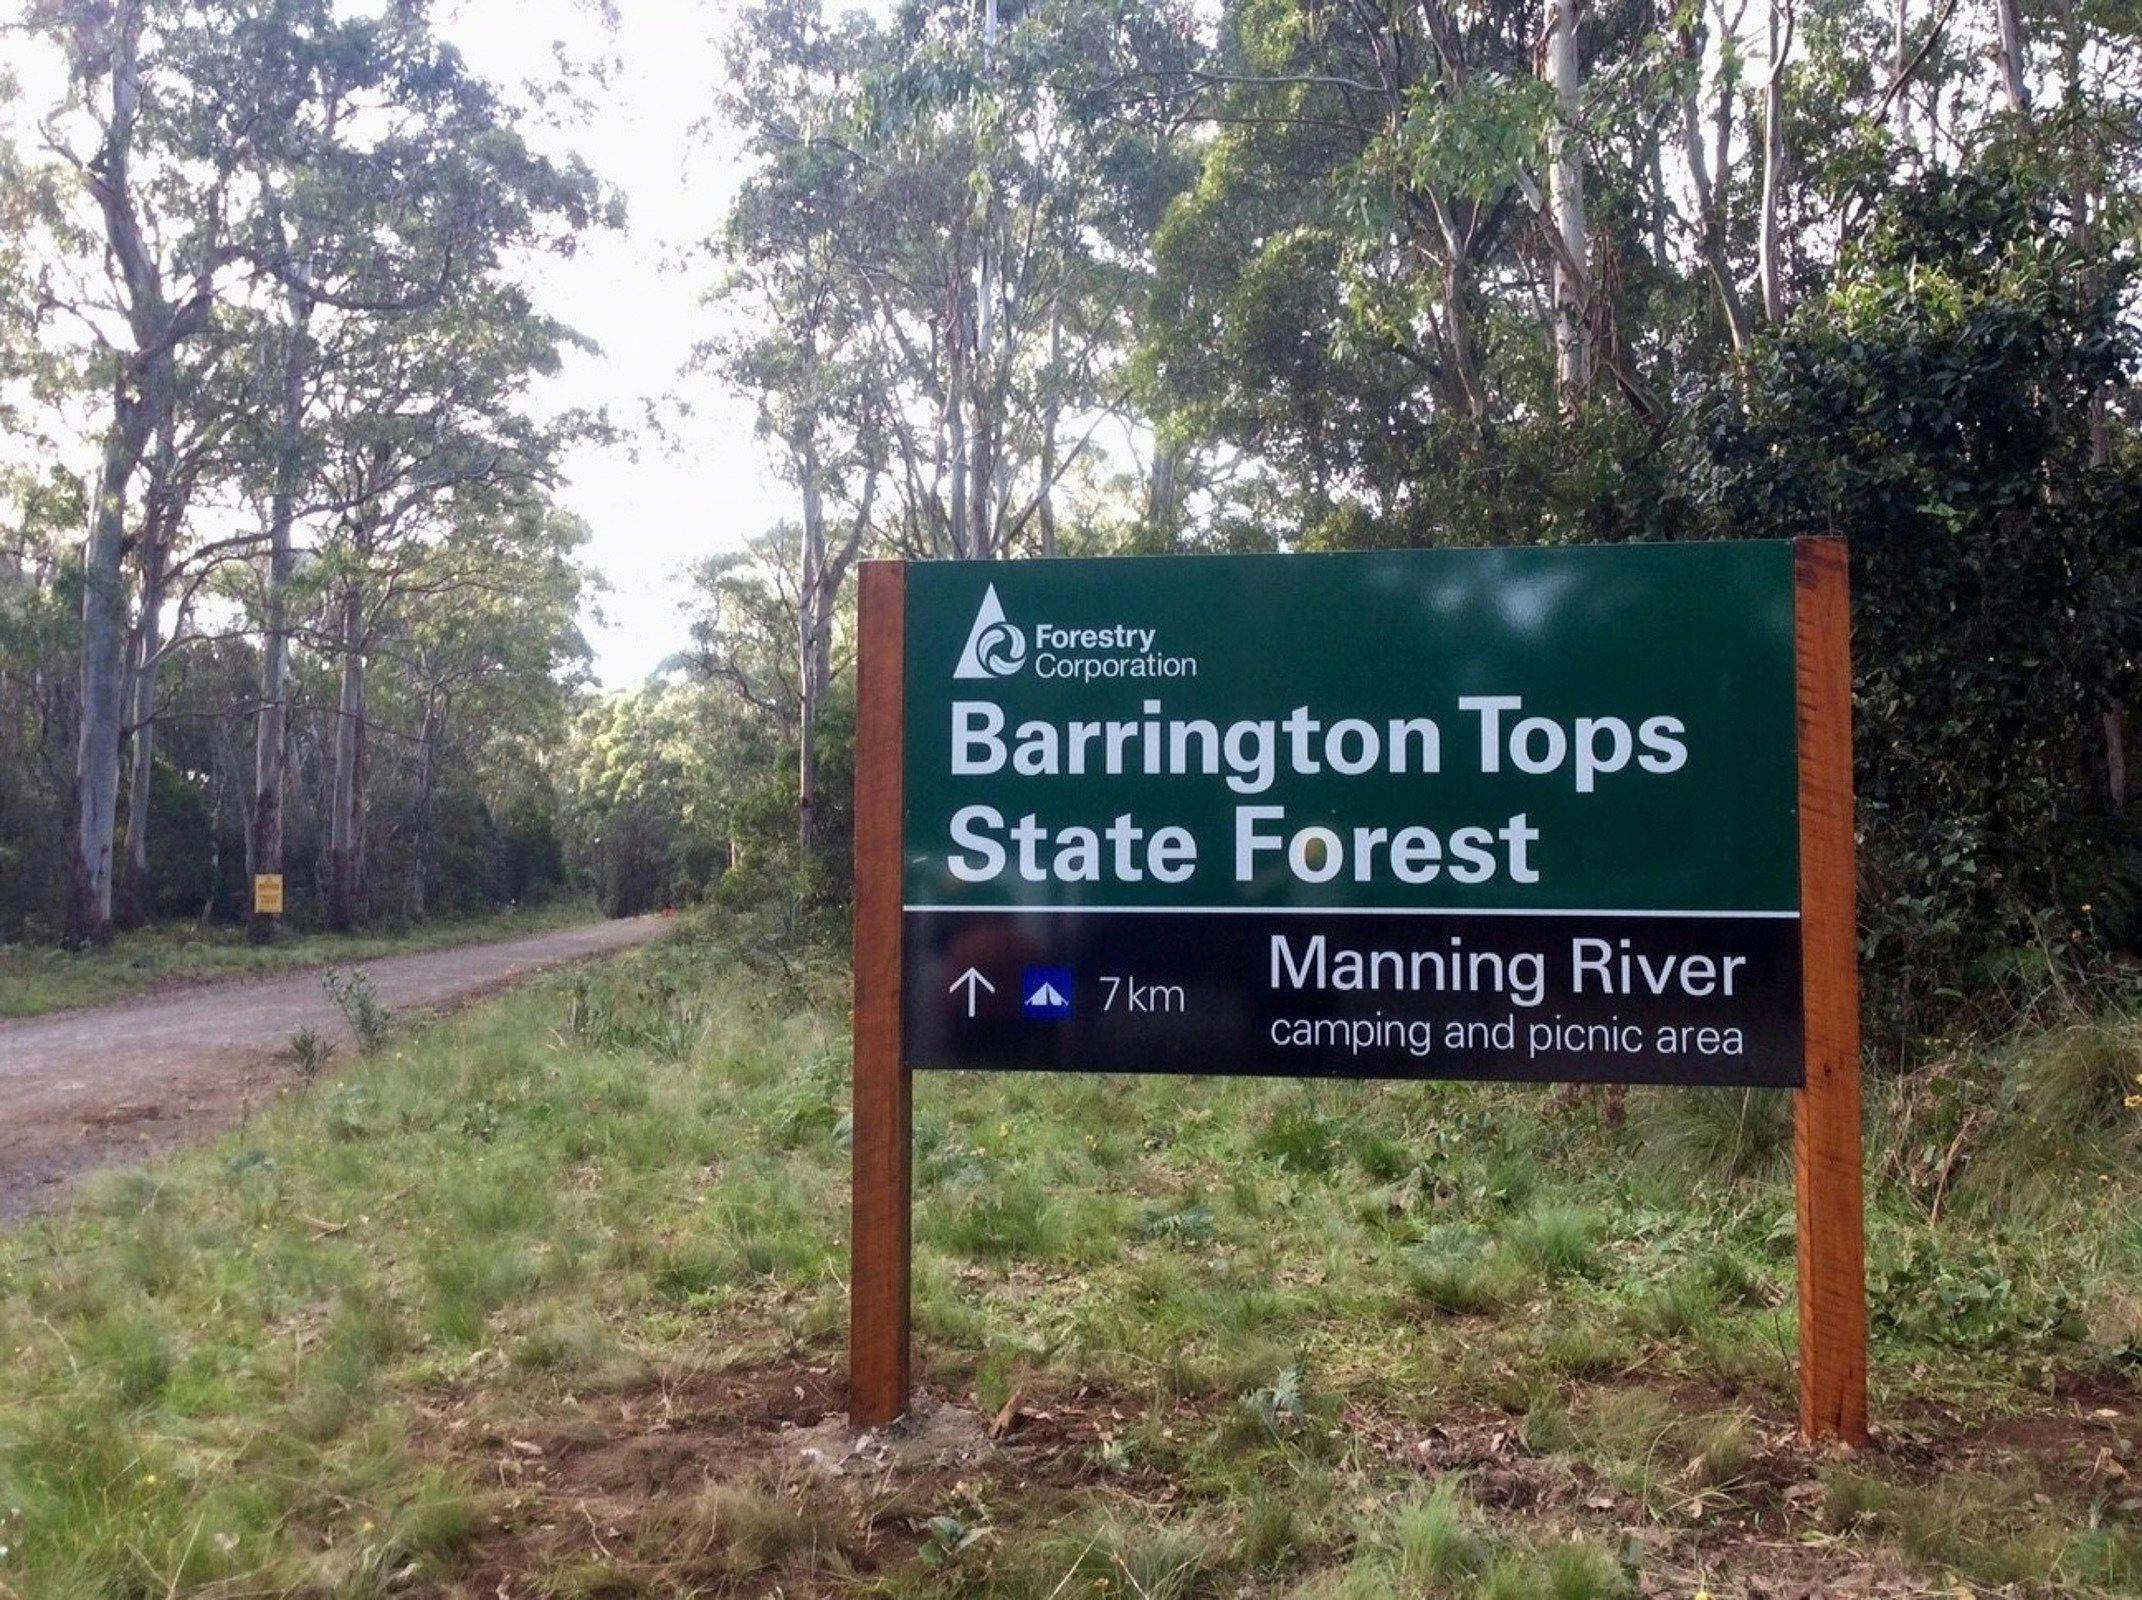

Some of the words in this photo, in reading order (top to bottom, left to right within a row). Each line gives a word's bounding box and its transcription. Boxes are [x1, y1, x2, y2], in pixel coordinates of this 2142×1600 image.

[1035, 652, 1196, 684] Corporation
[1036, 624, 1156, 654] Forestry
[951, 699, 1440, 794] Barrington
[1458, 695, 1688, 793] Tops
[947, 804, 1197, 883] State
[1235, 805, 1540, 884] Forest
[1271, 934, 1546, 1008] Manning
[1572, 938, 1746, 996] River
[1271, 1010, 1431, 1056] camping
[1445, 1013, 1515, 1050] and
[1529, 1014, 1643, 1059] picnic
[1656, 1026, 1743, 1055] area
